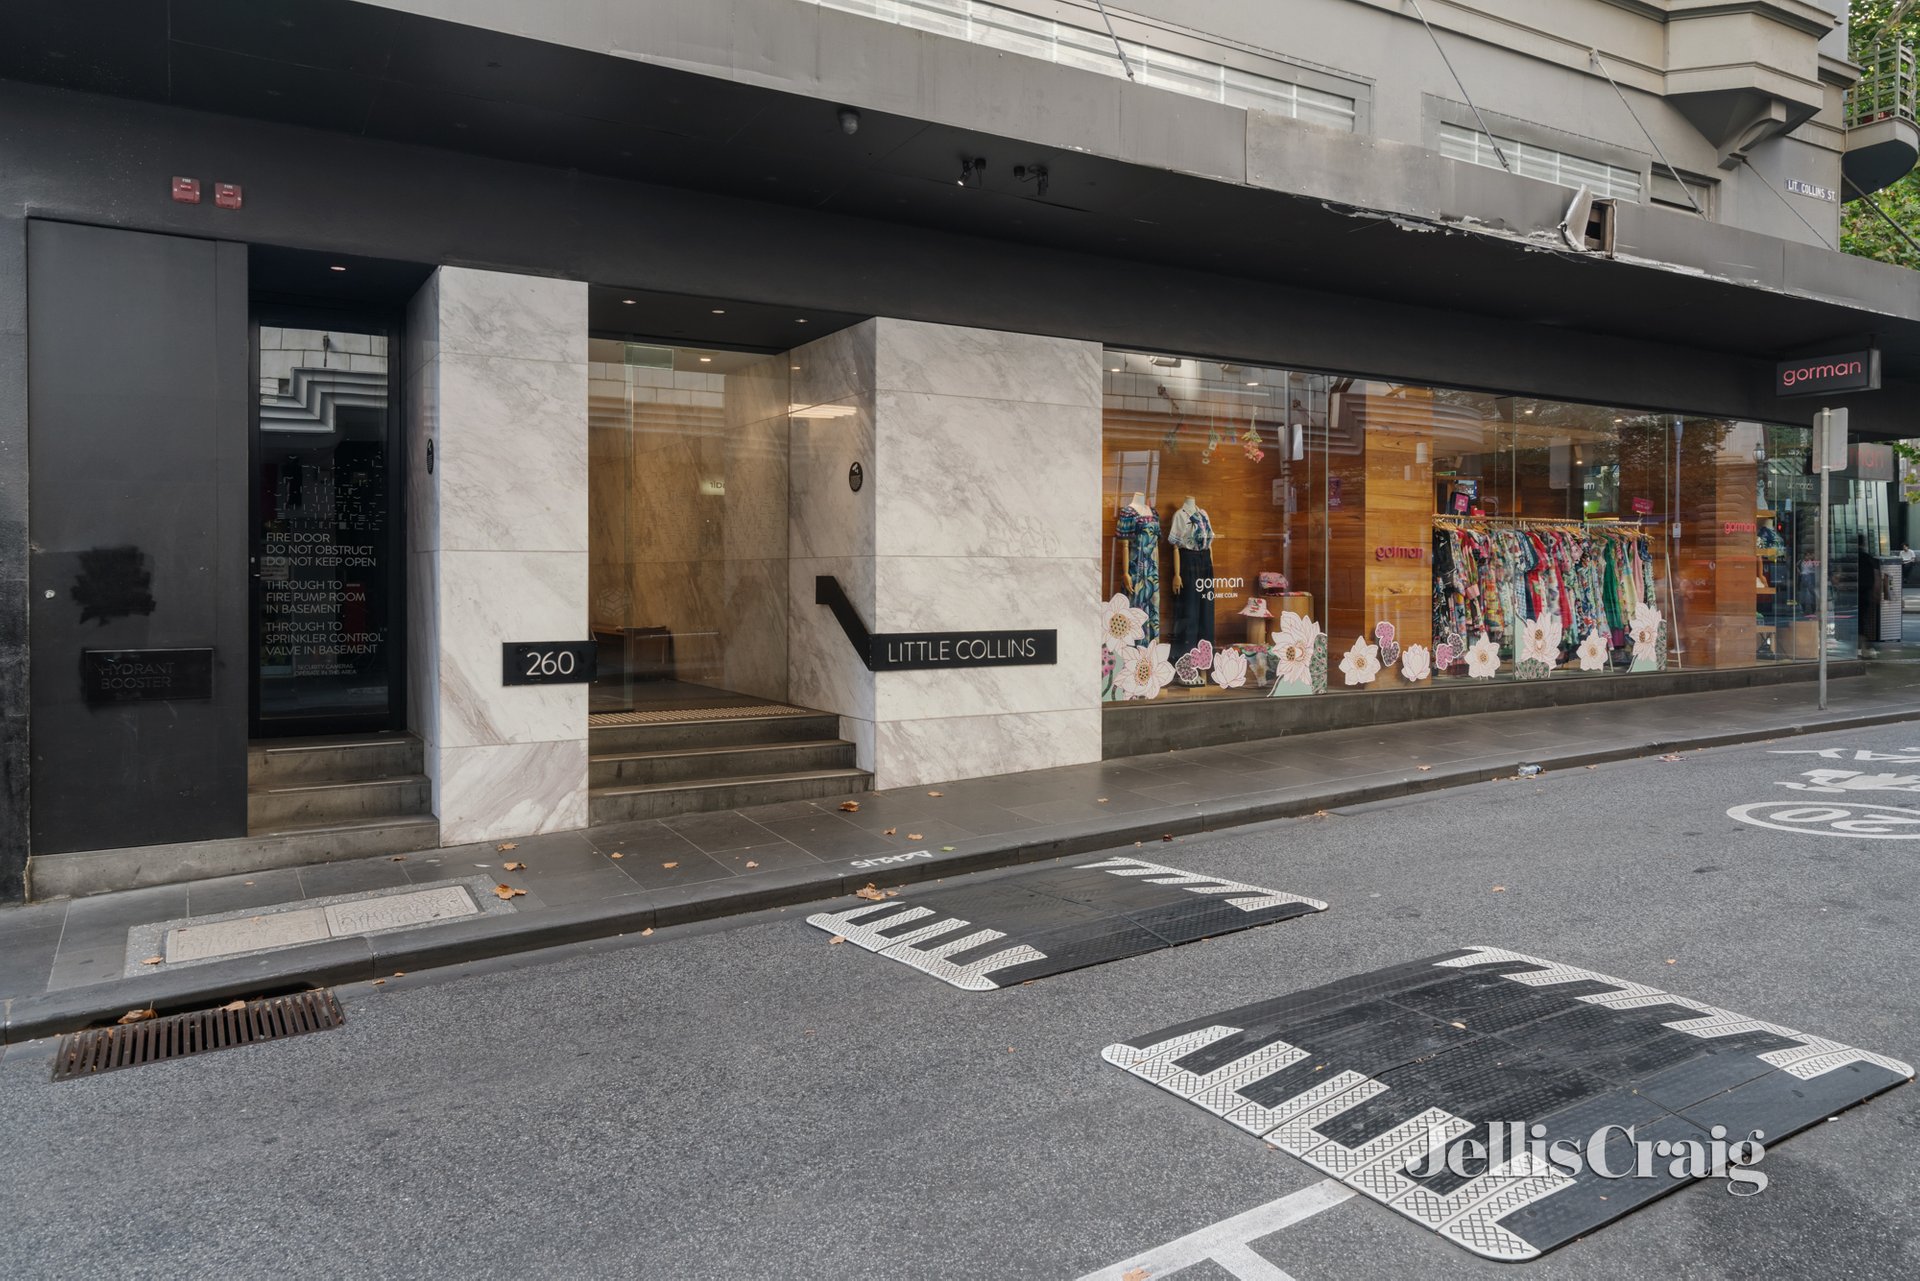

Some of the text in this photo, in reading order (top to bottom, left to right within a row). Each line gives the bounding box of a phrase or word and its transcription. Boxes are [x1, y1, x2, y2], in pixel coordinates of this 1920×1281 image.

[1801, 183, 1825, 199] COLLINS
[1783, 361, 1862, 386] gorman
[1724, 522, 1757, 535] gorman
[266, 532, 331, 543] FIRE DOOR
[266, 544, 374, 555] DO NOT OBSTRUCT
[1375, 545, 1425, 562] gorman
[266, 556, 377, 567] DO NOT KEEP OPEN
[266, 580, 343, 590] THROUGH TO
[1195, 577, 1244, 592] gorman
[266, 592, 366, 602] FIRE PUMP ROOM
[266, 604, 342, 614] IN BASEMENT
[265, 621, 343, 632] THROUGH TO
[265, 632, 384, 644] SPRINKLER CONTROL
[265, 644, 378, 656] VALVE IN BASEMENT
[888, 637, 1036, 662] LITTLE COLLINS
[101, 662, 175, 675] HYDRANT
[526, 650, 575, 676] 260
[101, 677, 172, 689] BOOSTER
